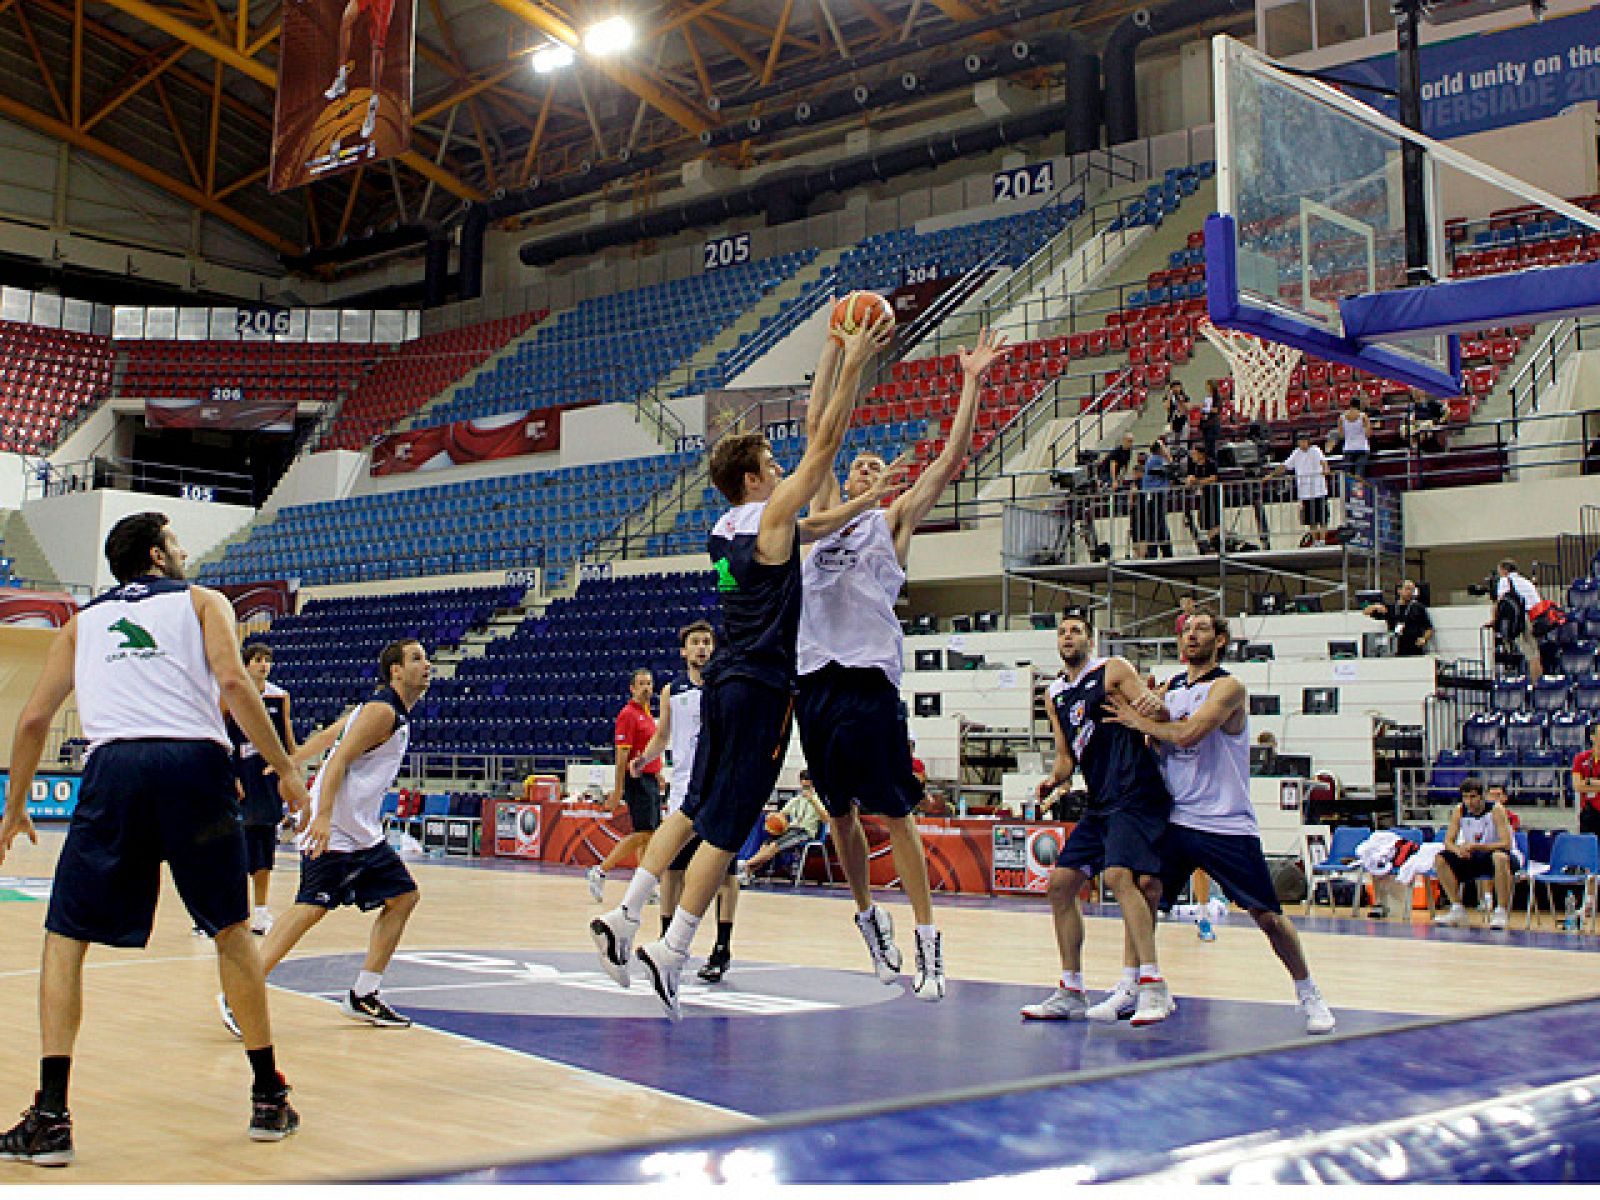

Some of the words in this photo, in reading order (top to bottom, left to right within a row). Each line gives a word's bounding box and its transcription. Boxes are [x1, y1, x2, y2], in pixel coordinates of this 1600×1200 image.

[1421, 72, 1463, 100] orld
[1469, 61, 1526, 90] unity
[1533, 54, 1561, 76] on
[994, 164, 1051, 200] 204
[704, 236, 749, 268] 205
[905, 264, 937, 285] 204
[237, 309, 290, 334] 206
